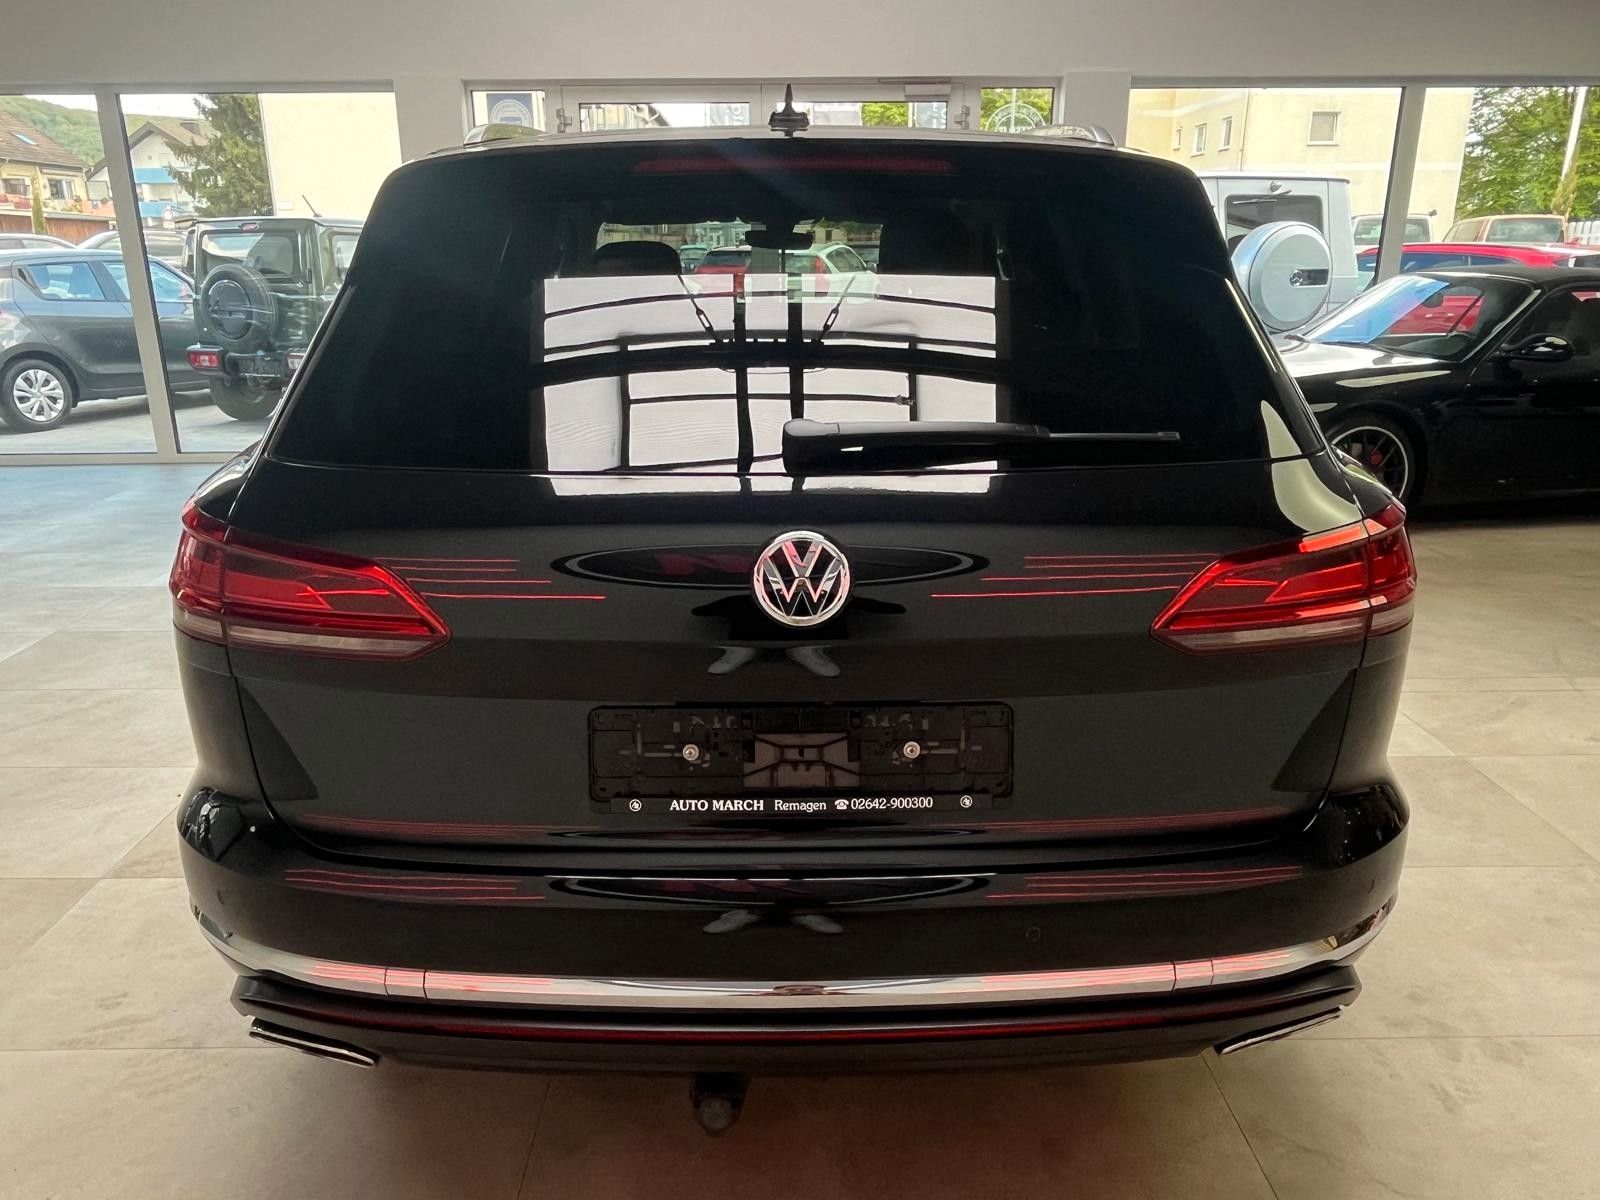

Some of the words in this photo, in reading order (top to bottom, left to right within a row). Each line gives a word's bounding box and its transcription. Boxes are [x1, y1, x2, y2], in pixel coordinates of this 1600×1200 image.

[757, 534, 847, 622] VW
[669, 799, 709, 811] AUTO
[712, 799, 764, 811] MARCH
[774, 799, 827, 813] Remagen
[850, 796, 934, 810] 02642-900300
